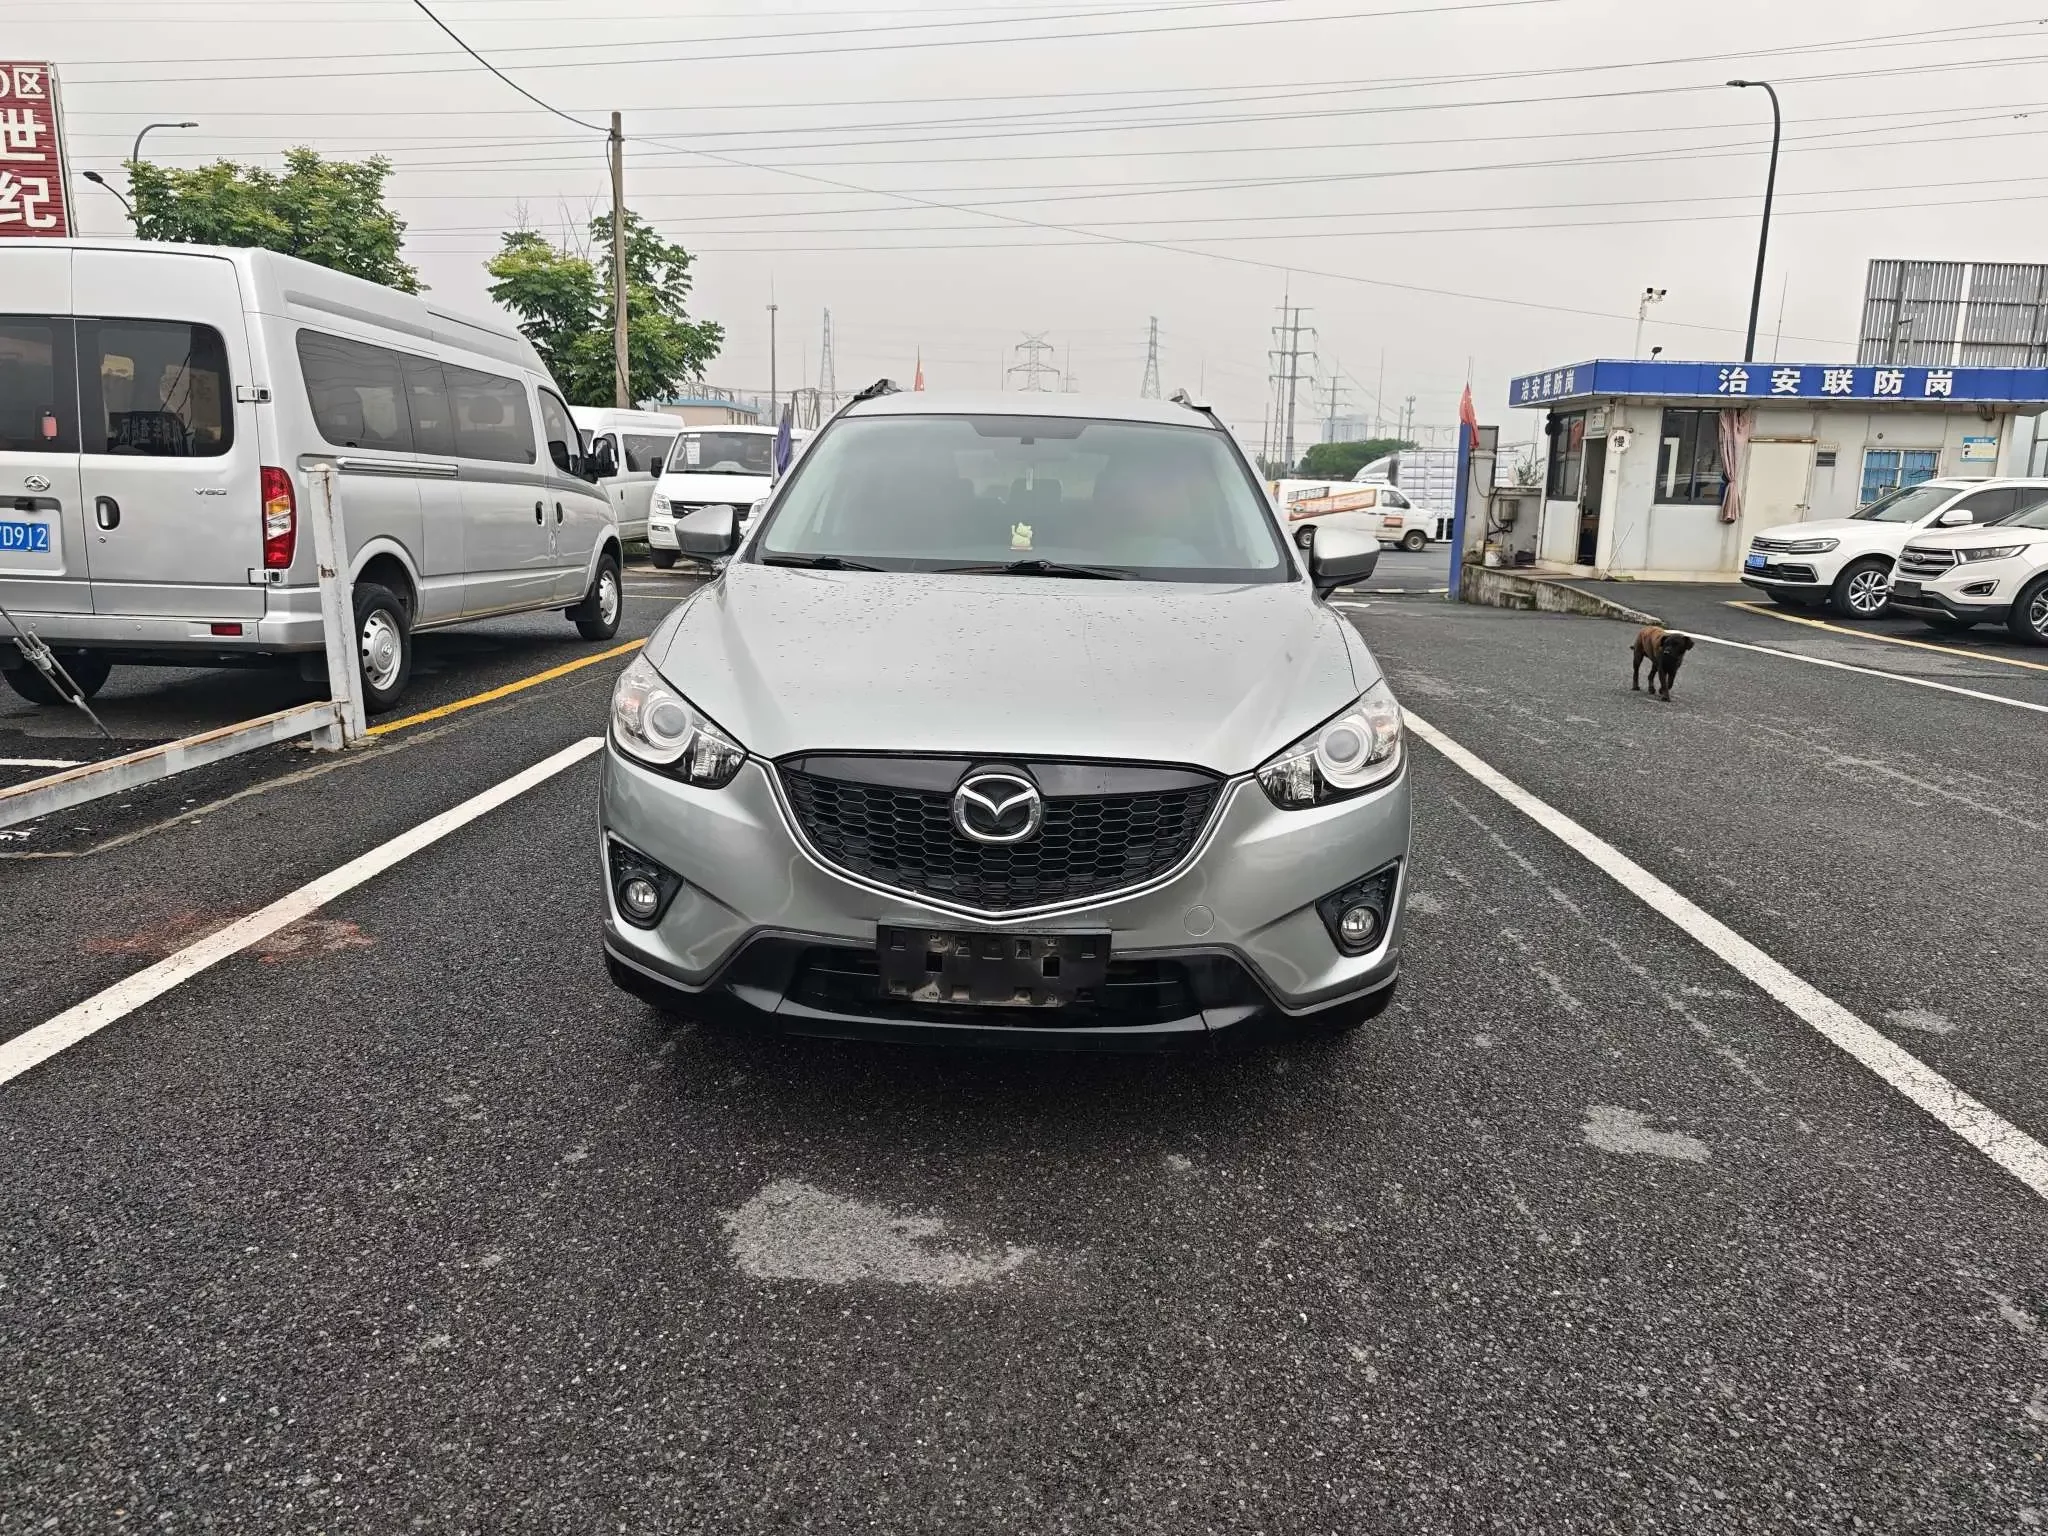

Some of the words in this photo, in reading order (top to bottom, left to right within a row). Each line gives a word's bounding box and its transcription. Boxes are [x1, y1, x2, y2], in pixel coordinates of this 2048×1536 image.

[1521, 368, 1575, 401] 治安联防岗
[1718, 367, 1953, 396] 治安联防岗
[1613, 435, 1625, 448] 慢
[1663, 437, 1680, 498] 1
[0, 525, 48, 548] D912
